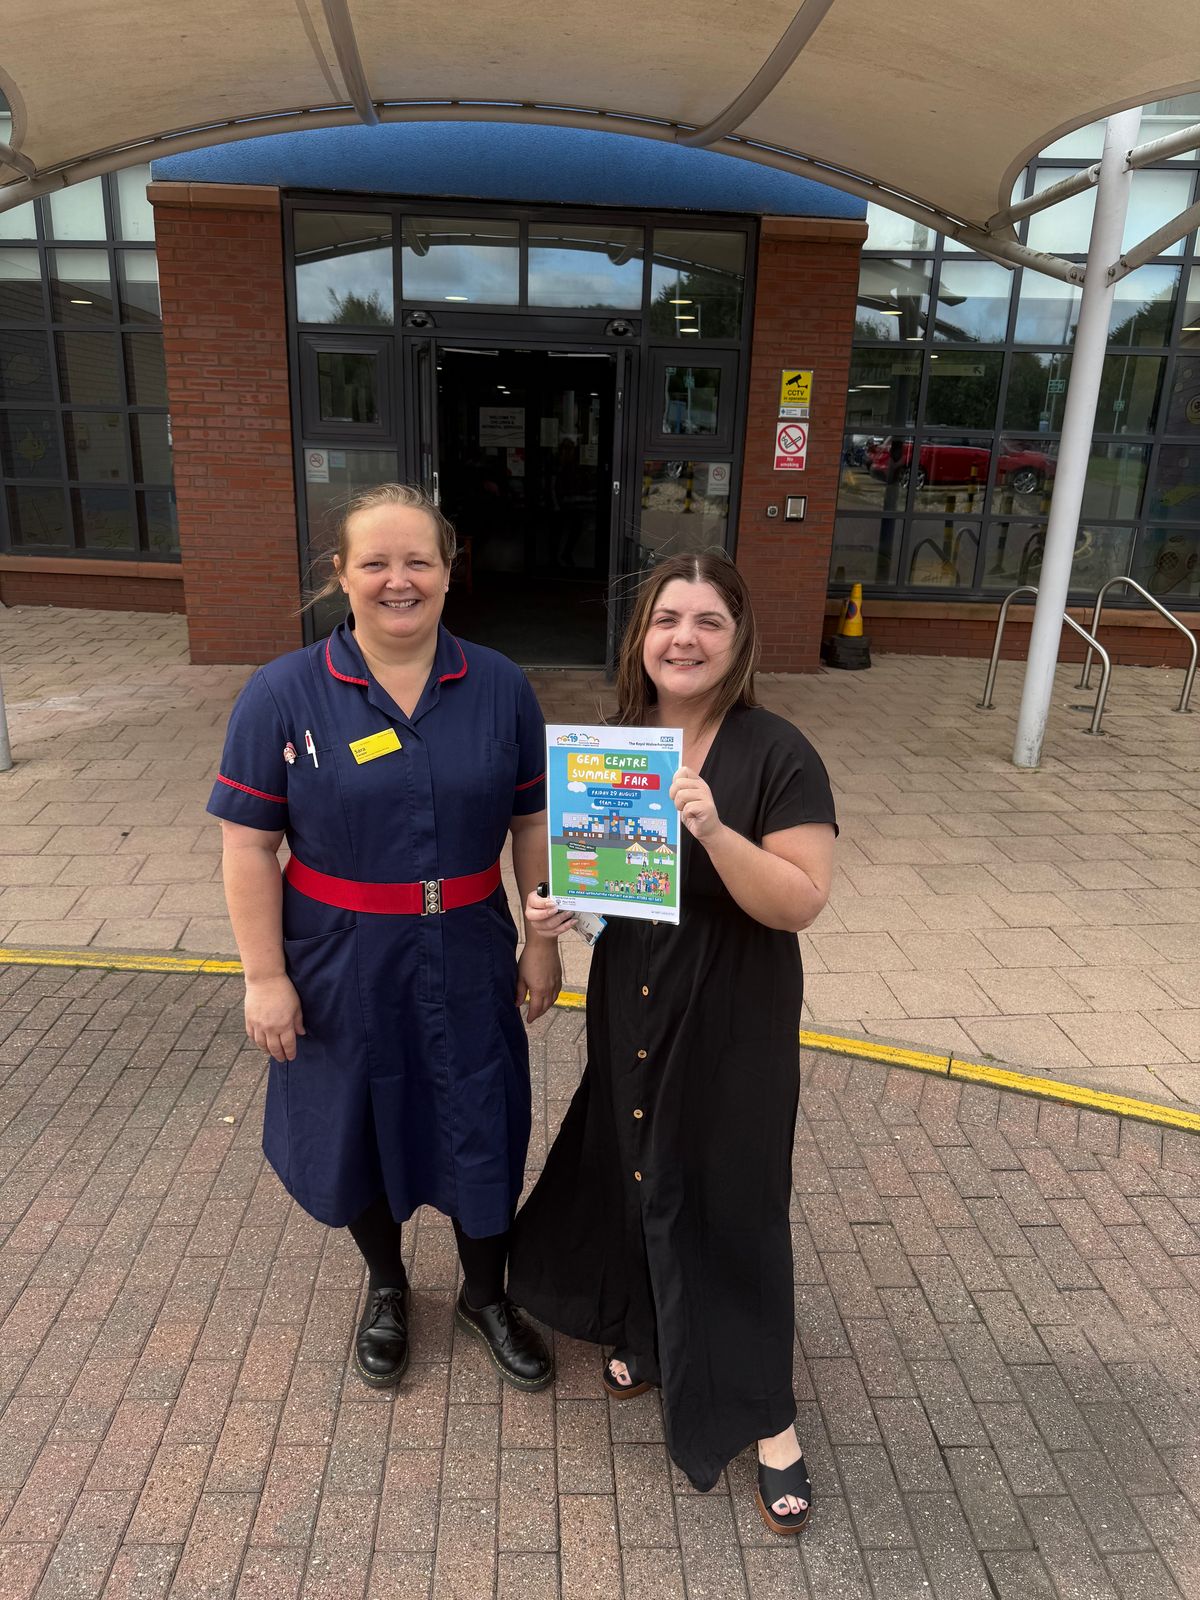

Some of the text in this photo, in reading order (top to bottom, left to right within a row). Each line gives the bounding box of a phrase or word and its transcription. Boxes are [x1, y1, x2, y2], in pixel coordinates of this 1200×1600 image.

[576, 754, 647, 768] GEM CENTRE
[572, 769, 648, 786] SUMMER FAIR
